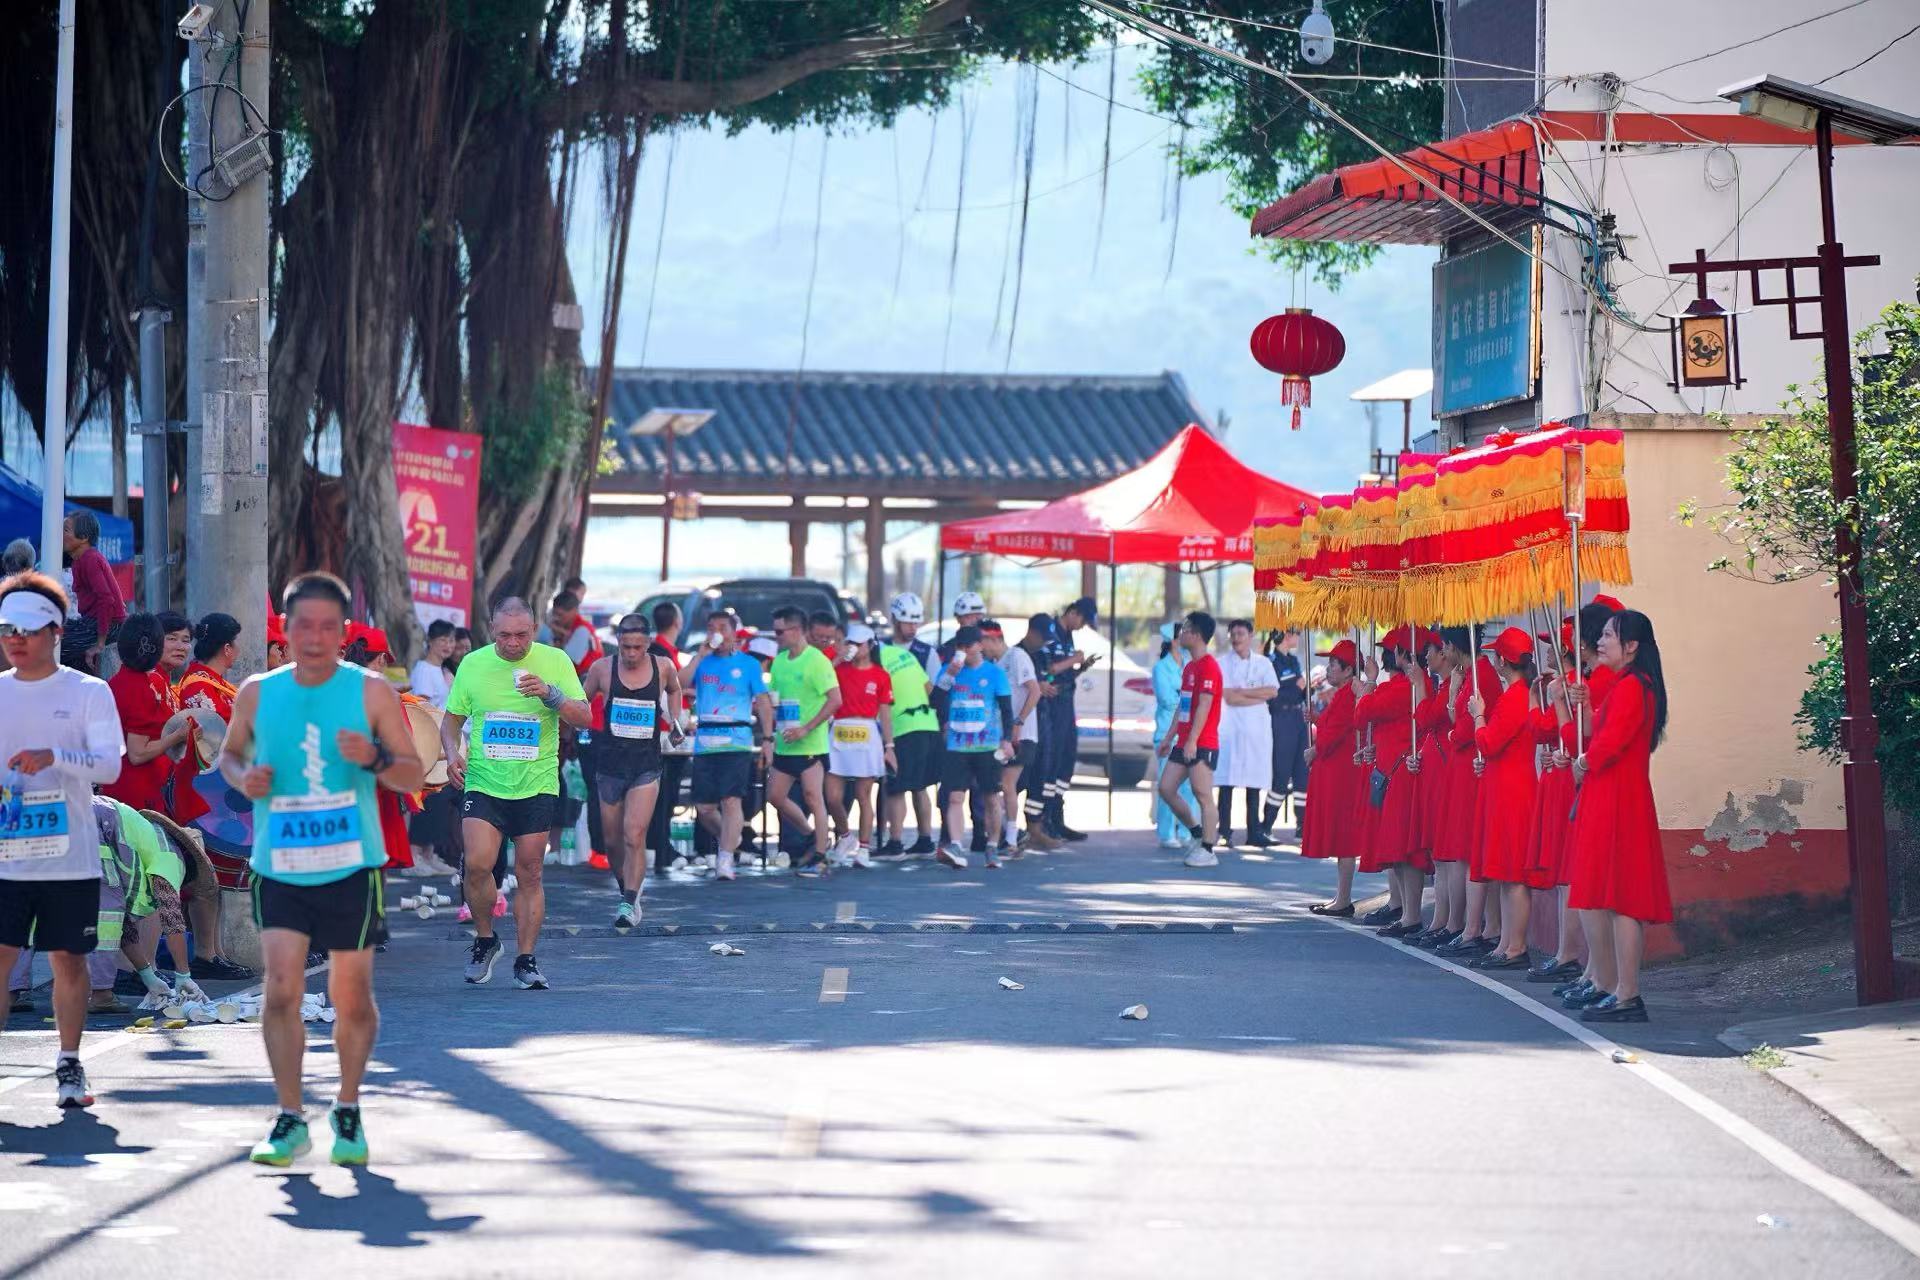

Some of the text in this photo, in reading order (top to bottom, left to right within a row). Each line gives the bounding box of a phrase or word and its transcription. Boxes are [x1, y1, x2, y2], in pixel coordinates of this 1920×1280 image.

[412, 523, 447, 556] 21
[615, 711, 650, 723] A0603
[488, 727, 534, 740] A0882
[281, 816, 349, 839] A1004
